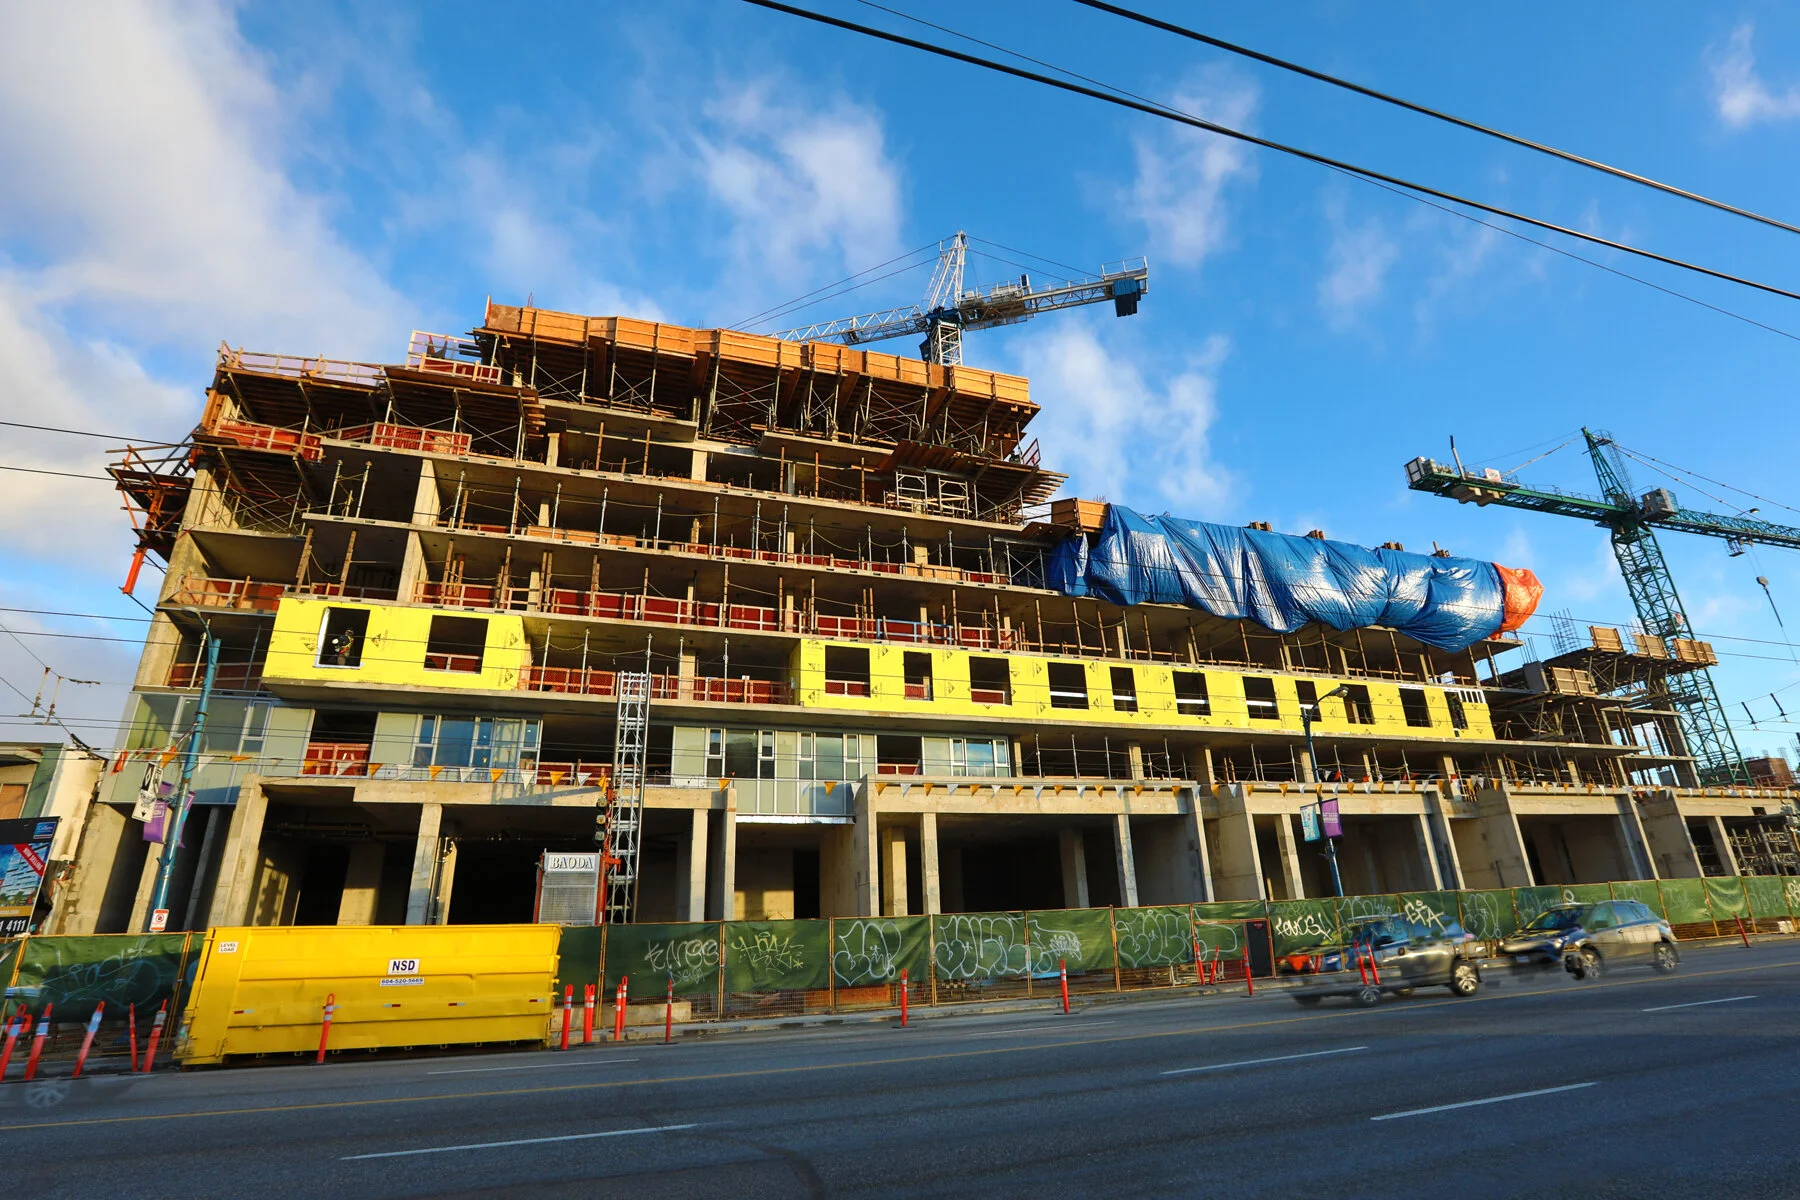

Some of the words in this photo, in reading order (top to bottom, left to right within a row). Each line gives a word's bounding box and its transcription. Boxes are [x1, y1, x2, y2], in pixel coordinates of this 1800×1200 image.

[550, 857, 593, 869] BAODA
[6, 920, 26, 931] 4111
[392, 960, 415, 971] NSD
